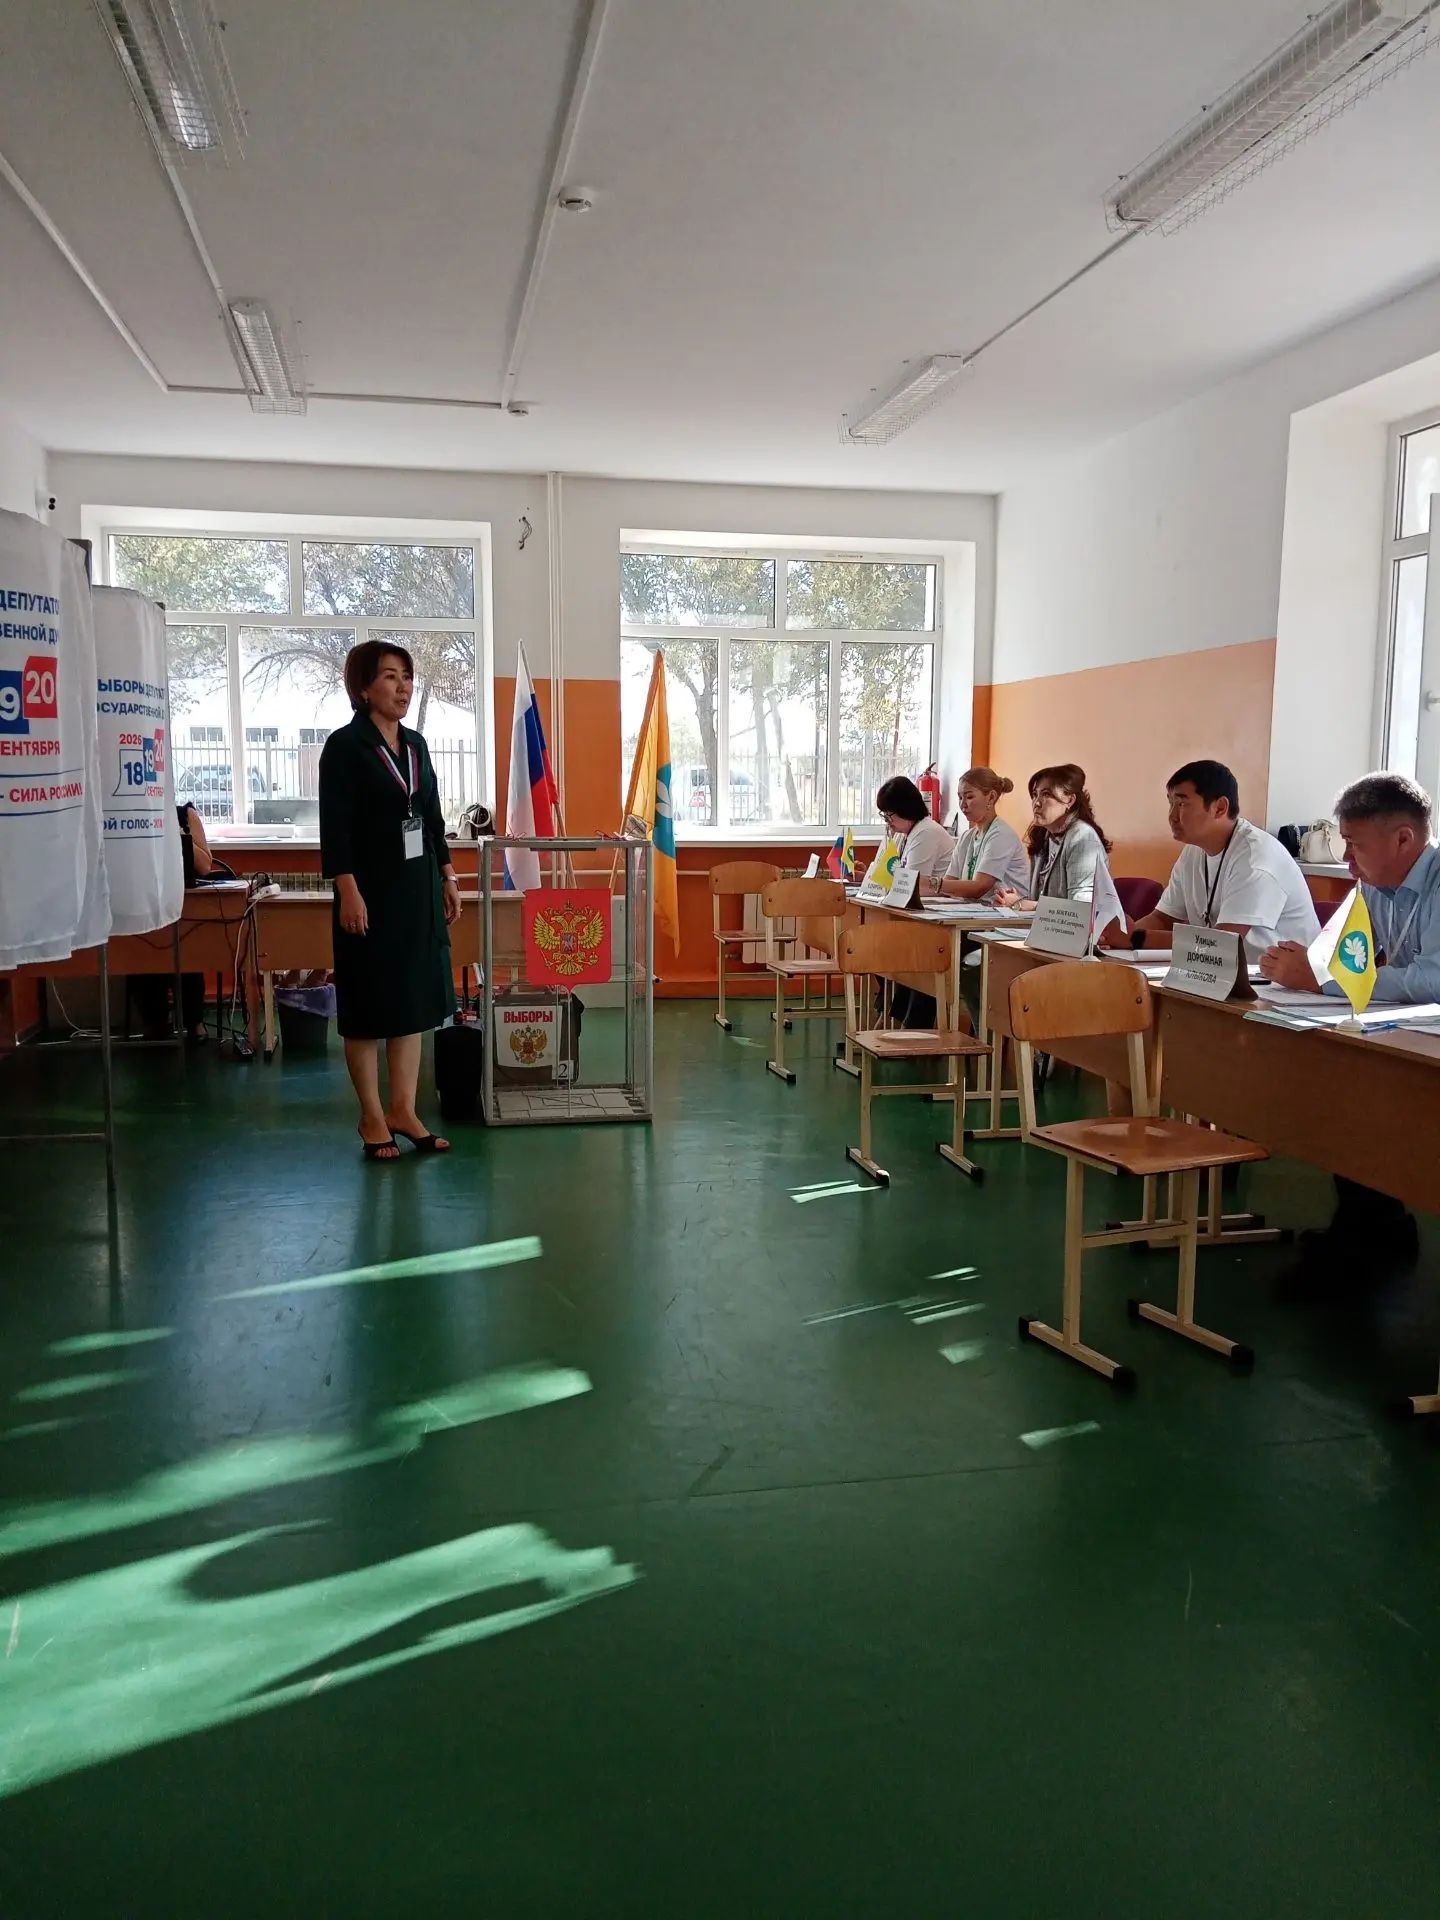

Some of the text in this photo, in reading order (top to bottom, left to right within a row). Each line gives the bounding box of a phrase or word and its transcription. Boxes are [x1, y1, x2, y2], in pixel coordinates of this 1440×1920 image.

[0, 622, 47, 642] ЕННОЙ
[26, 670, 55, 704] 20
[119, 733, 143, 746] 2026
[124, 761, 144, 786] 18
[144, 748, 155, 773] 19
[9, 787, 48, 803] СИЛА
[120, 818, 150, 830] ГОЛОС
[1186, 951, 1223, 967] ДОРОЖНАЯ
[503, 1010, 553, 1024] ВЫБОРЫ
[558, 1063, 568, 1078] 2
